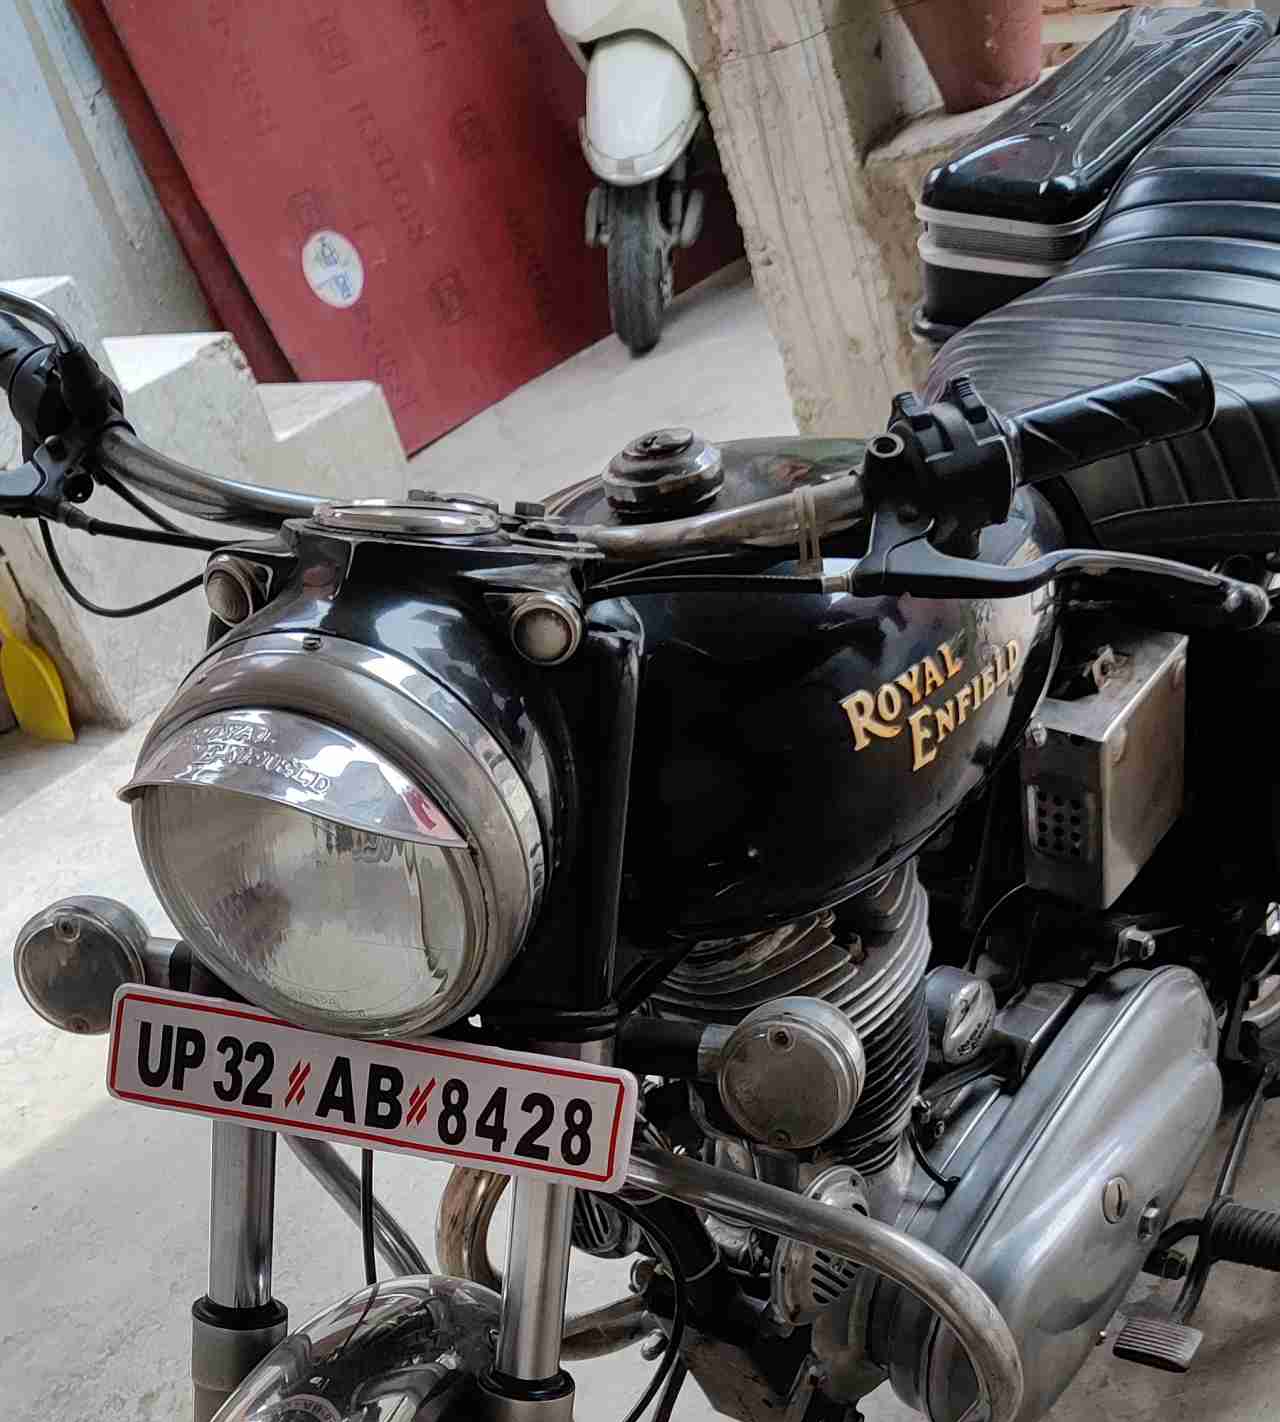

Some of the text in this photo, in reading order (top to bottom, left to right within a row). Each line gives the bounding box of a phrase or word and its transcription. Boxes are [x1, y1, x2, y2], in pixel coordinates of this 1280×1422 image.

[838, 640, 965, 752] ROYAL
[907, 638, 1019, 772] ENFIELD
[135, 1021, 594, 1166] UP 32 AB 8428
